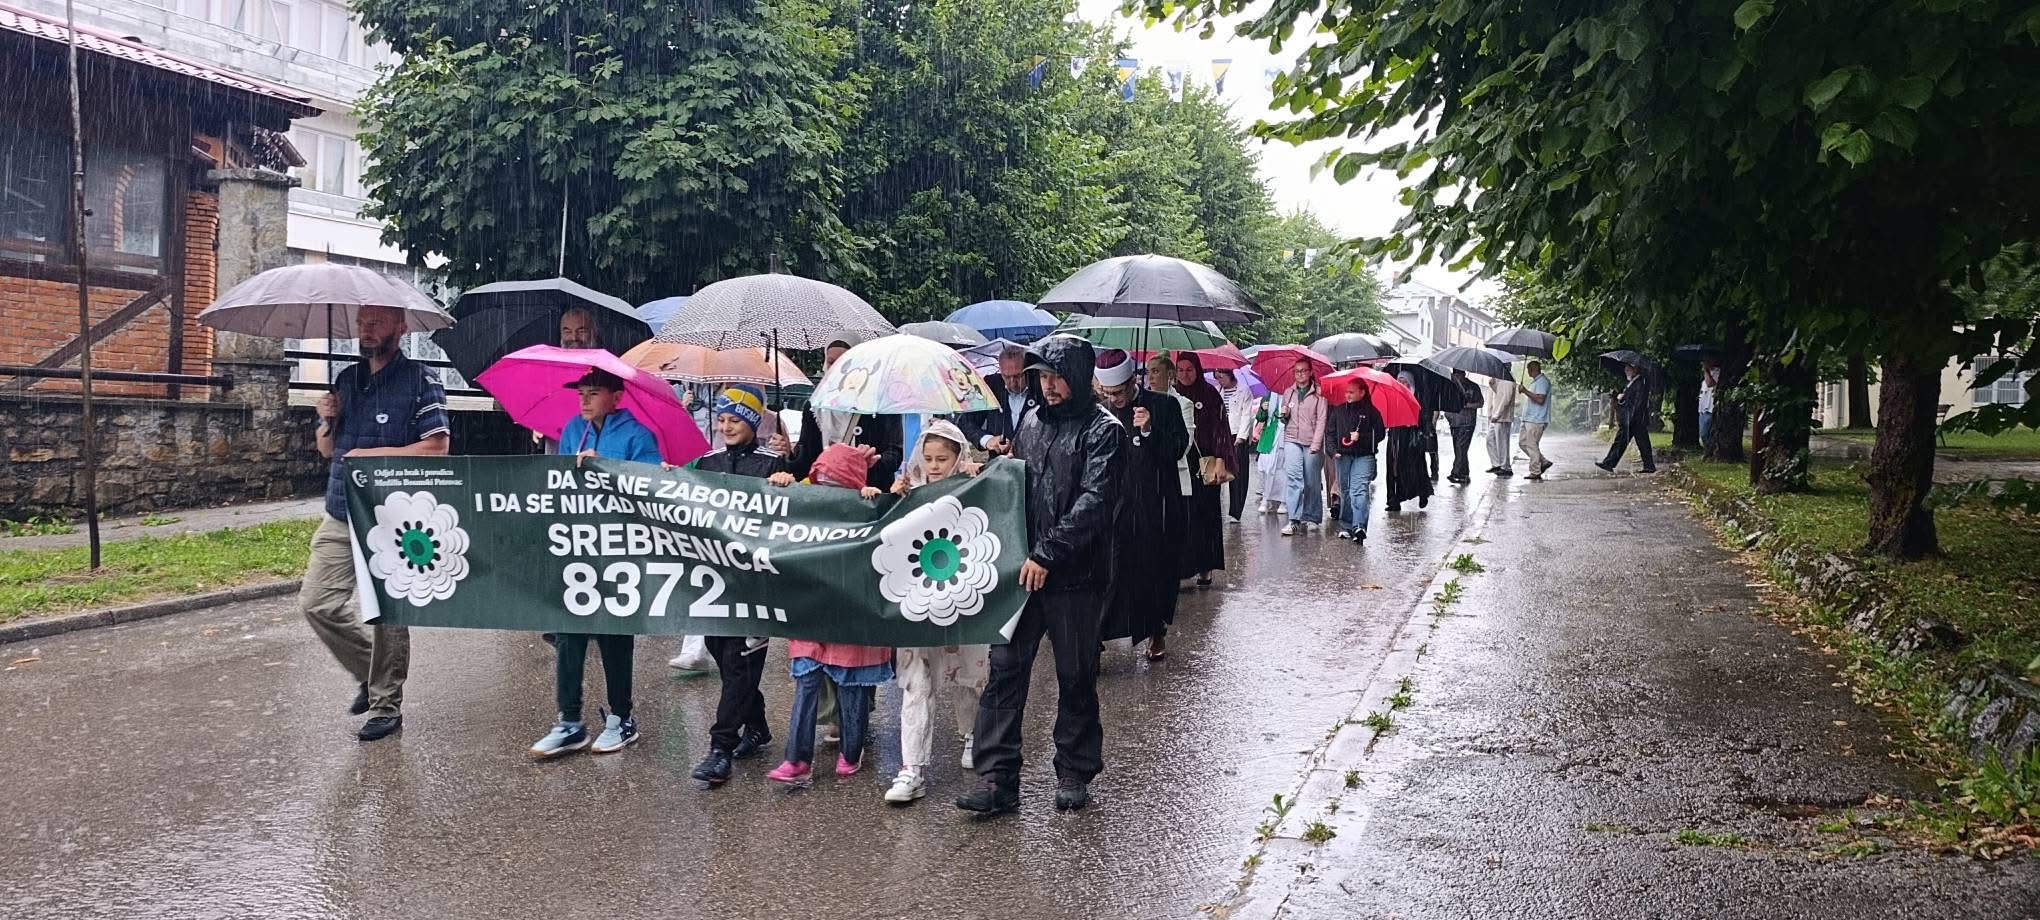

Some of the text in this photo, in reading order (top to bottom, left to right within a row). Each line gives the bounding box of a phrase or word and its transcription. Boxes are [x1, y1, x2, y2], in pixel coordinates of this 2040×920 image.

[475, 493, 874, 543] I DA SE NIKAD NIKOM NE PONOVI
[547, 470, 789, 517] DA SE NE ZABORAVI
[548, 522, 780, 575] SREBRENICA
[563, 562, 788, 623] 8372...
